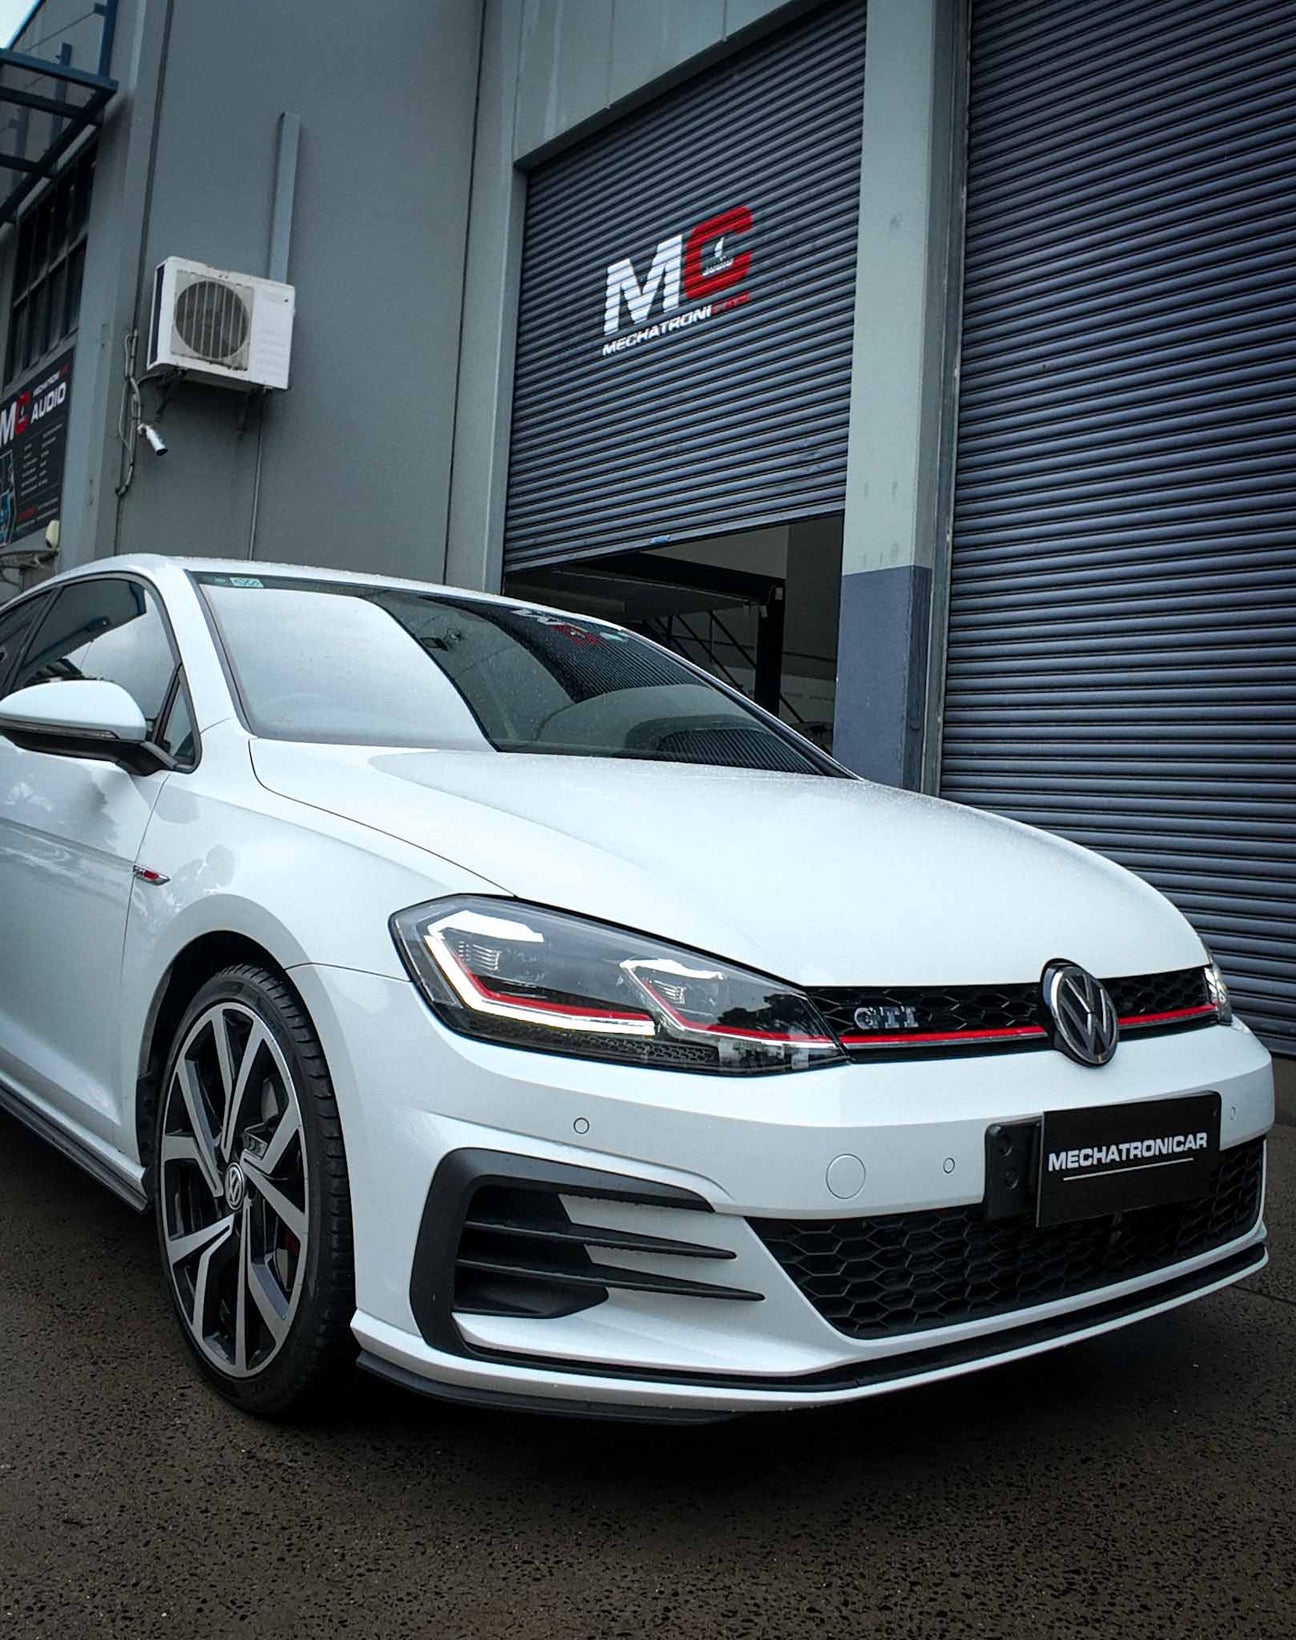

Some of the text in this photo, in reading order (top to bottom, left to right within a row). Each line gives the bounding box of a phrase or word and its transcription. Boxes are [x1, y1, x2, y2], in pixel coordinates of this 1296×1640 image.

[604, 205, 753, 336] MC
[31, 381, 67, 424] AUDIO
[853, 1005, 920, 1030] GTI
[1048, 1132, 1208, 1172] MECHATRONICAR
